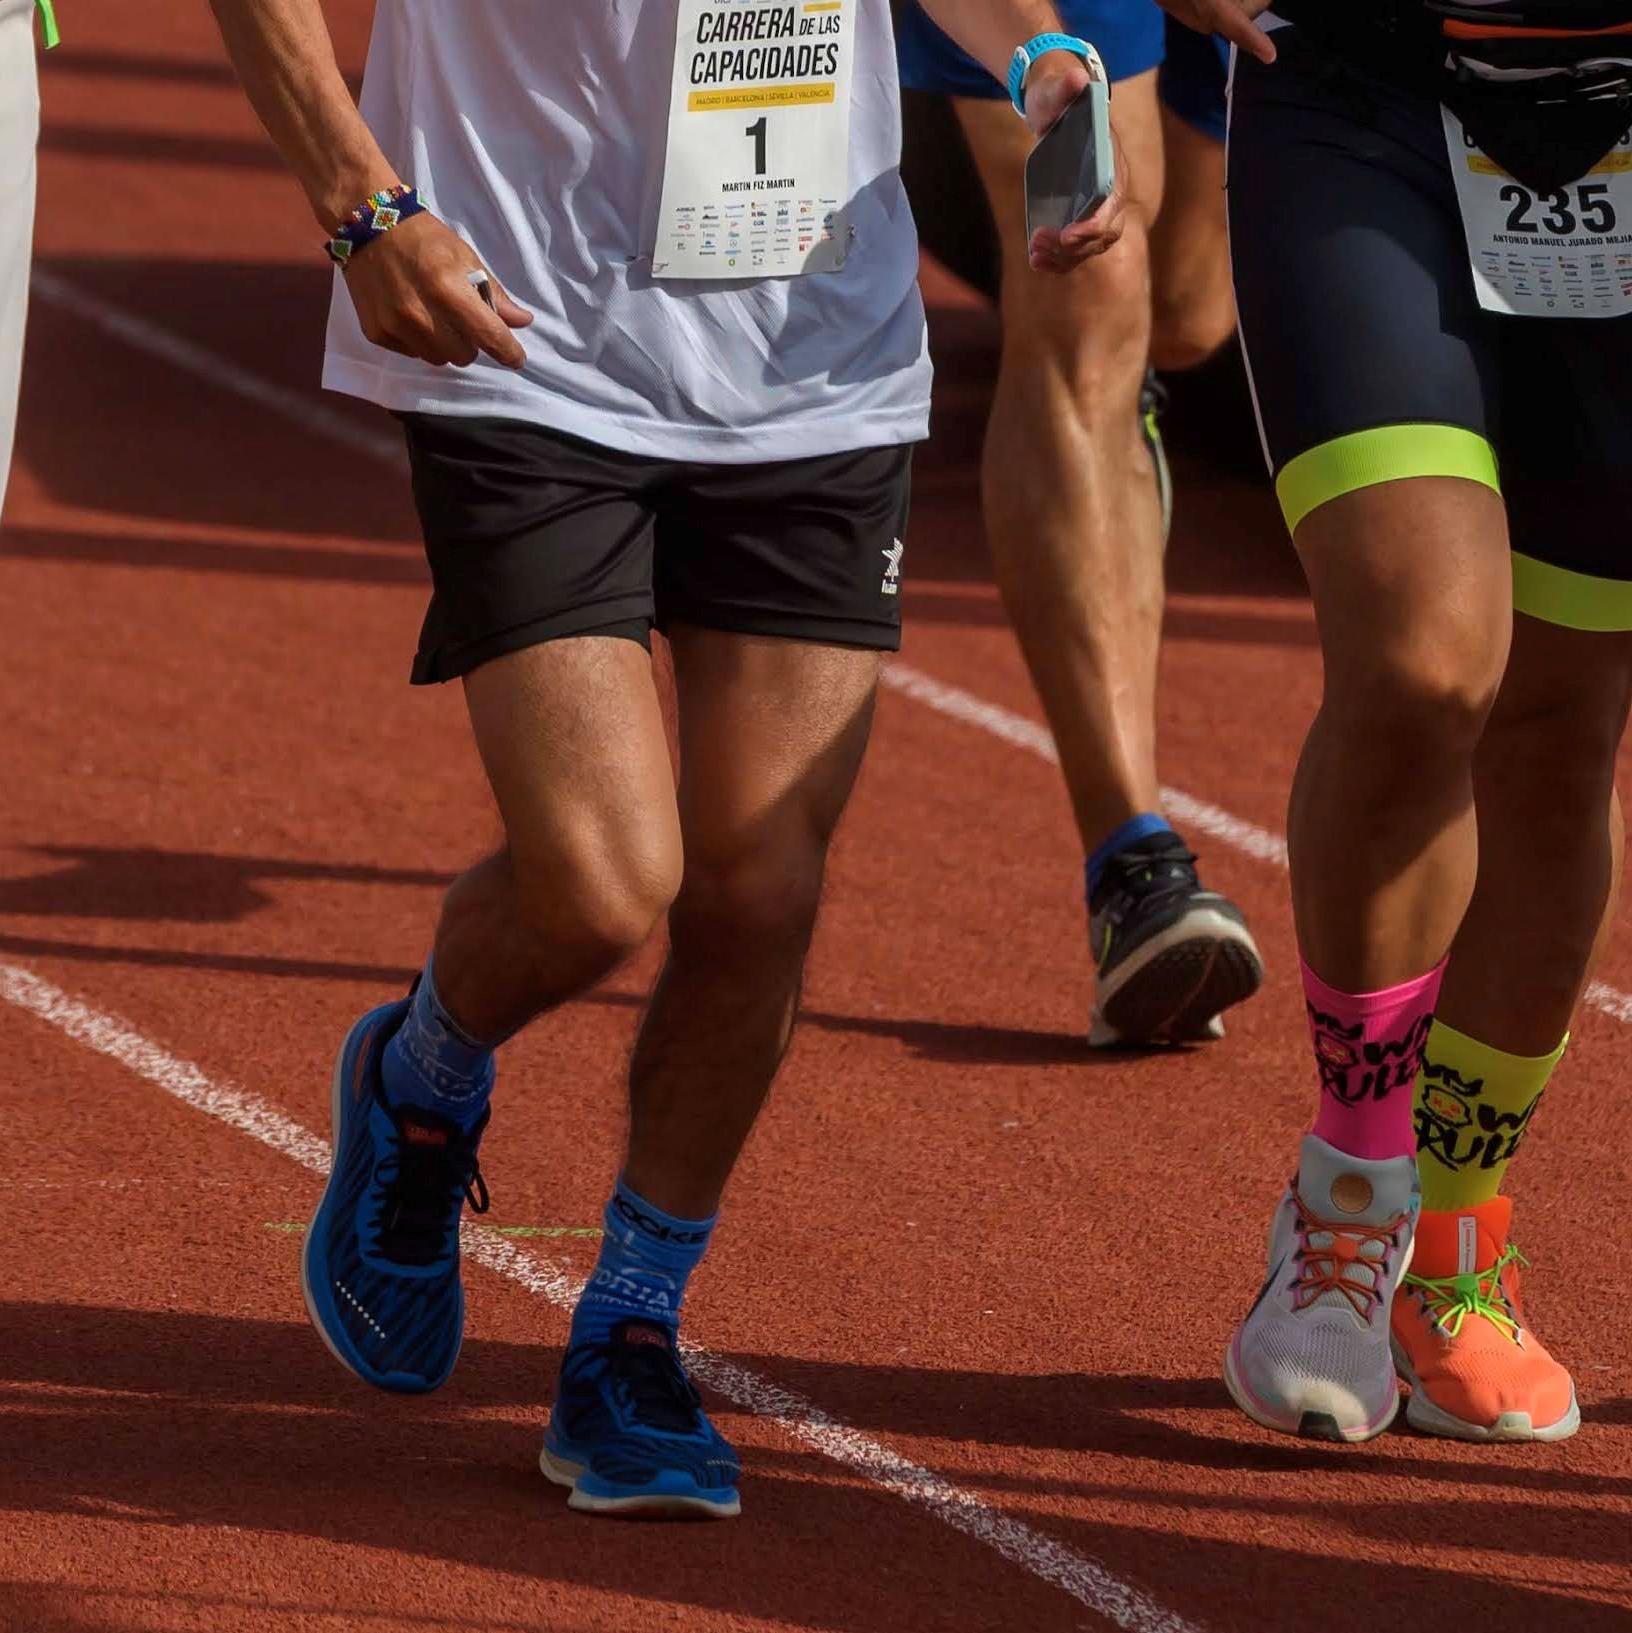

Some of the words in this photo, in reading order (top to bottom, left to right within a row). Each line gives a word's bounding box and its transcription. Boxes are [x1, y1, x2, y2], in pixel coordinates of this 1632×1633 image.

[696, 6, 795, 44] CARRERA
[799, 18, 815, 35] DE
[818, 16, 840, 35] LAS
[690, 43, 839, 85] CAPACIDADES
[726, 93, 765, 104] BARCELONA
[767, 90, 794, 101] SEVILLA
[798, 89, 830, 99] VALENCIA
[745, 117, 767, 175] 1
[722, 180, 751, 193] MARTIN
[753, 179, 765, 191] FIZ
[766, 178, 796, 190] MARTIN
[1499, 183, 1617, 235] 235
[1492, 233, 1529, 246] ANTONIO
[1531, 237, 1566, 247] MANUEL
[1568, 235, 1603, 247] JURADO
